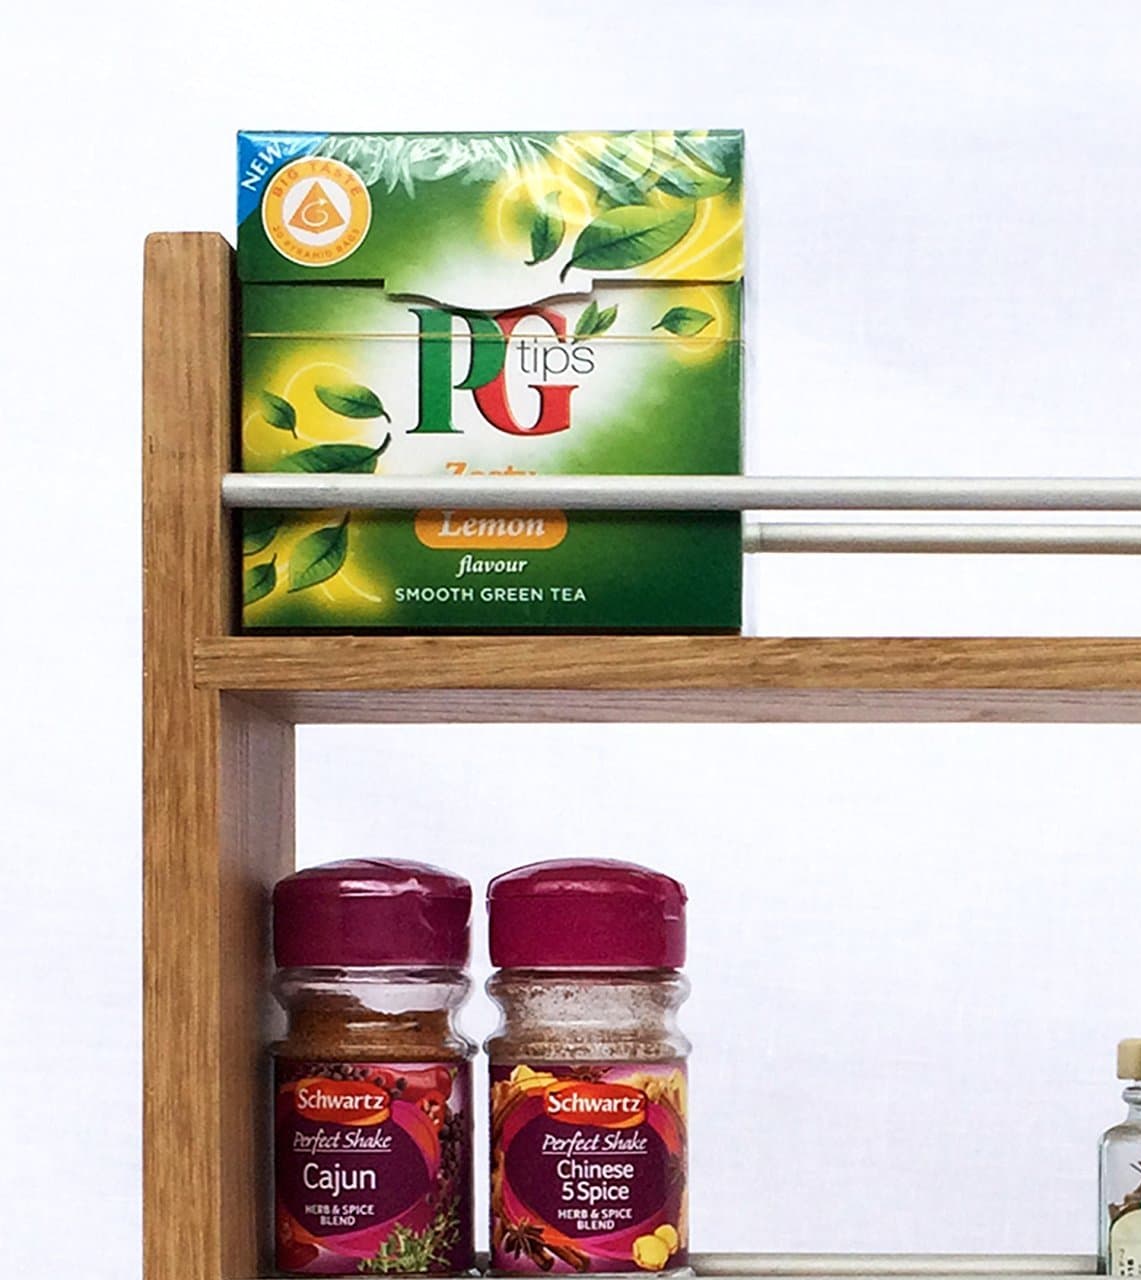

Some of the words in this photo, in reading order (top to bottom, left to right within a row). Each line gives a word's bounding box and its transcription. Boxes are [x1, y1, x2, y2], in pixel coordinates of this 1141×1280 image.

[241, 141, 282, 191] NEW
[272, 168, 299, 197] BIG
[310, 162, 361, 197] TASTE
[406, 307, 579, 436] PG
[516, 336, 597, 382] tips
[437, 510, 545, 537] Lemon
[455, 554, 528, 578] flavour
[395, 588, 474, 602] SMOOTH
[480, 588, 543, 602] GREEN
[550, 588, 586, 602] TEA
[297, 1088, 384, 1110] Schwartz
[547, 1093, 641, 1113] Schwartz
[293, 1129, 340, 1155] Perfect
[342, 1129, 392, 1149] Shake
[542, 1131, 600, 1157] Perfect
[602, 1131, 648, 1150] Shake
[303, 1163, 376, 1197] Cajun
[557, 1159, 635, 1180] Chinese
[562, 1181, 574, 1200] 5
[576, 1181, 630, 1205] Spice
[320, 1216, 356, 1226] BLEND
[342, 1205, 375, 1216] SPICE
[557, 1209, 588, 1219] HERB
[590, 1209, 600, 1219] &
[602, 1209, 632, 1219] SPICE
[577, 1220, 615, 1230] BLEND
